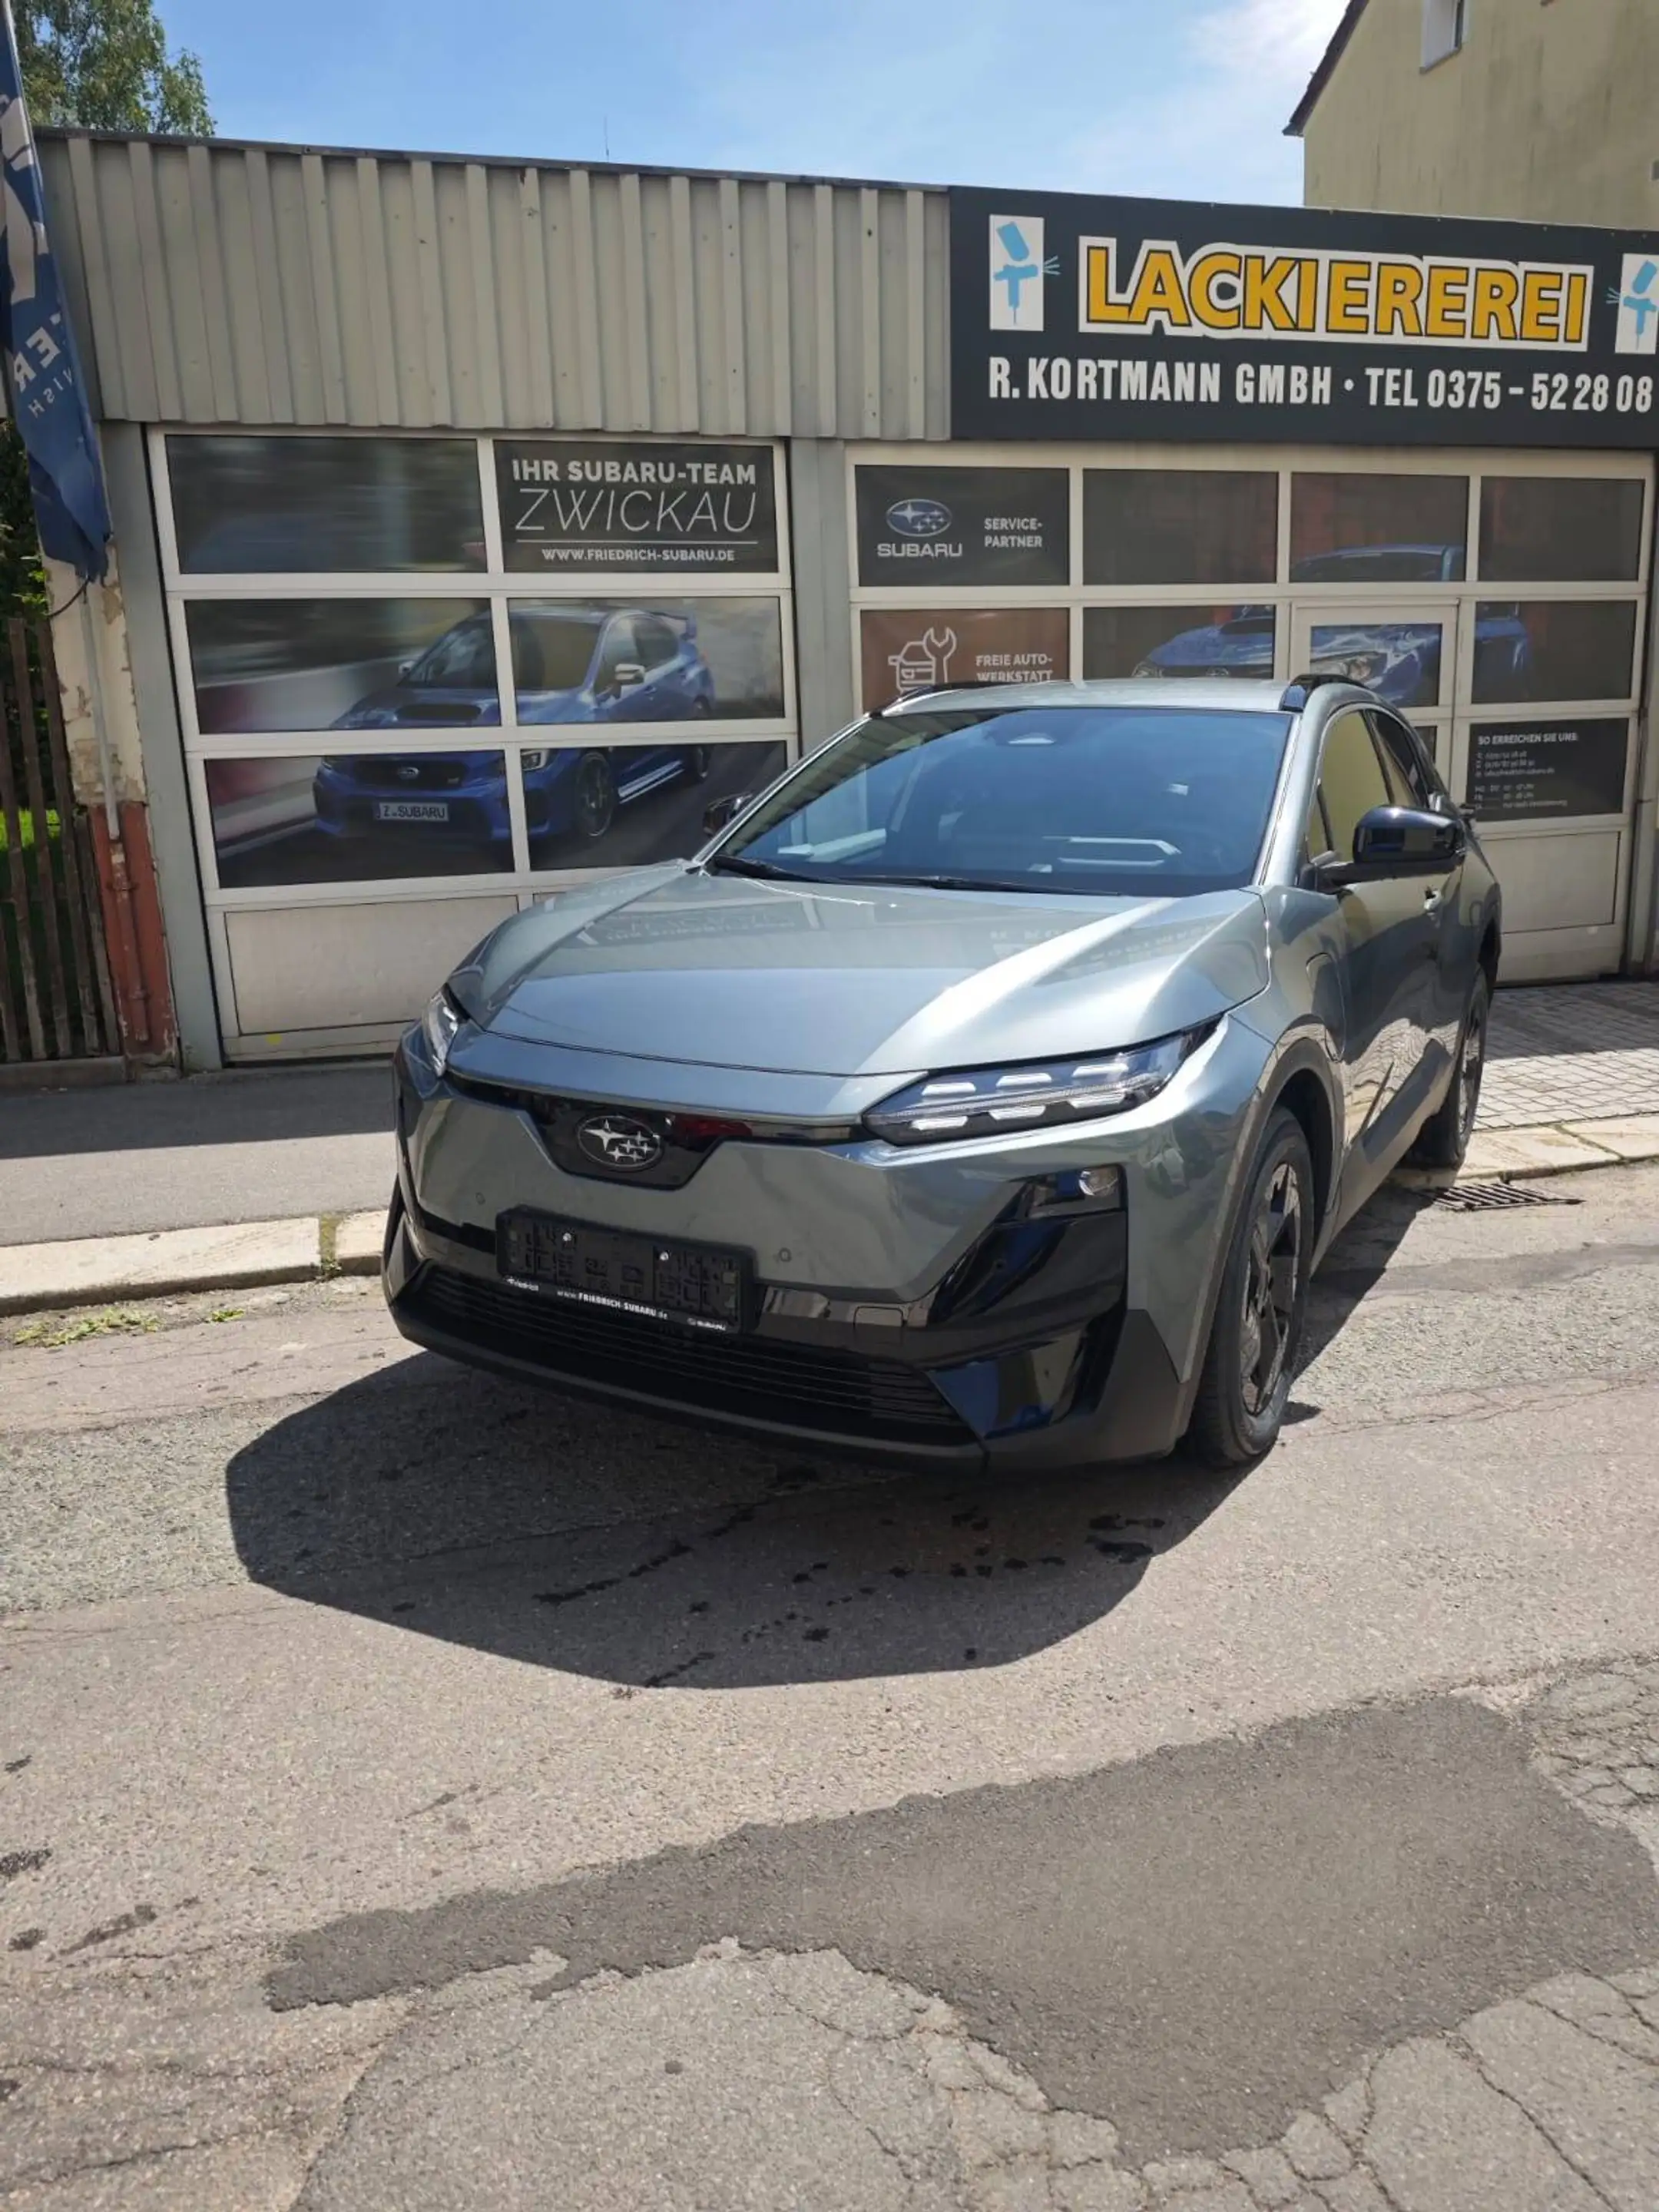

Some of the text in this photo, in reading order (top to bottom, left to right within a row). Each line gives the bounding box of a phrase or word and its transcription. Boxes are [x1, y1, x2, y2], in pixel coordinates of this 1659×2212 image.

[1084, 244, 1590, 346] LACKIEREREI
[988, 356, 1020, 399] R.
[1028, 358, 1220, 402] KORTMANN
[1235, 363, 1331, 405] GMBH
[1365, 367, 1419, 406] TEL
[1427, 369, 1502, 409] 0375
[512, 459, 756, 485] IHR SUBARU-TEAM
[515, 488, 757, 533] ZWICKAU
[984, 518, 1043, 531] SERVICE-
[984, 535, 1043, 548] PARTNER
[541, 548, 735, 562] WWW.FRIEDRICH-SUBARU.DE
[877, 542, 963, 558] SUBARU
[975, 653, 1053, 667] FREIE AUTO-
[976, 669, 1054, 682] WERKSTATT
